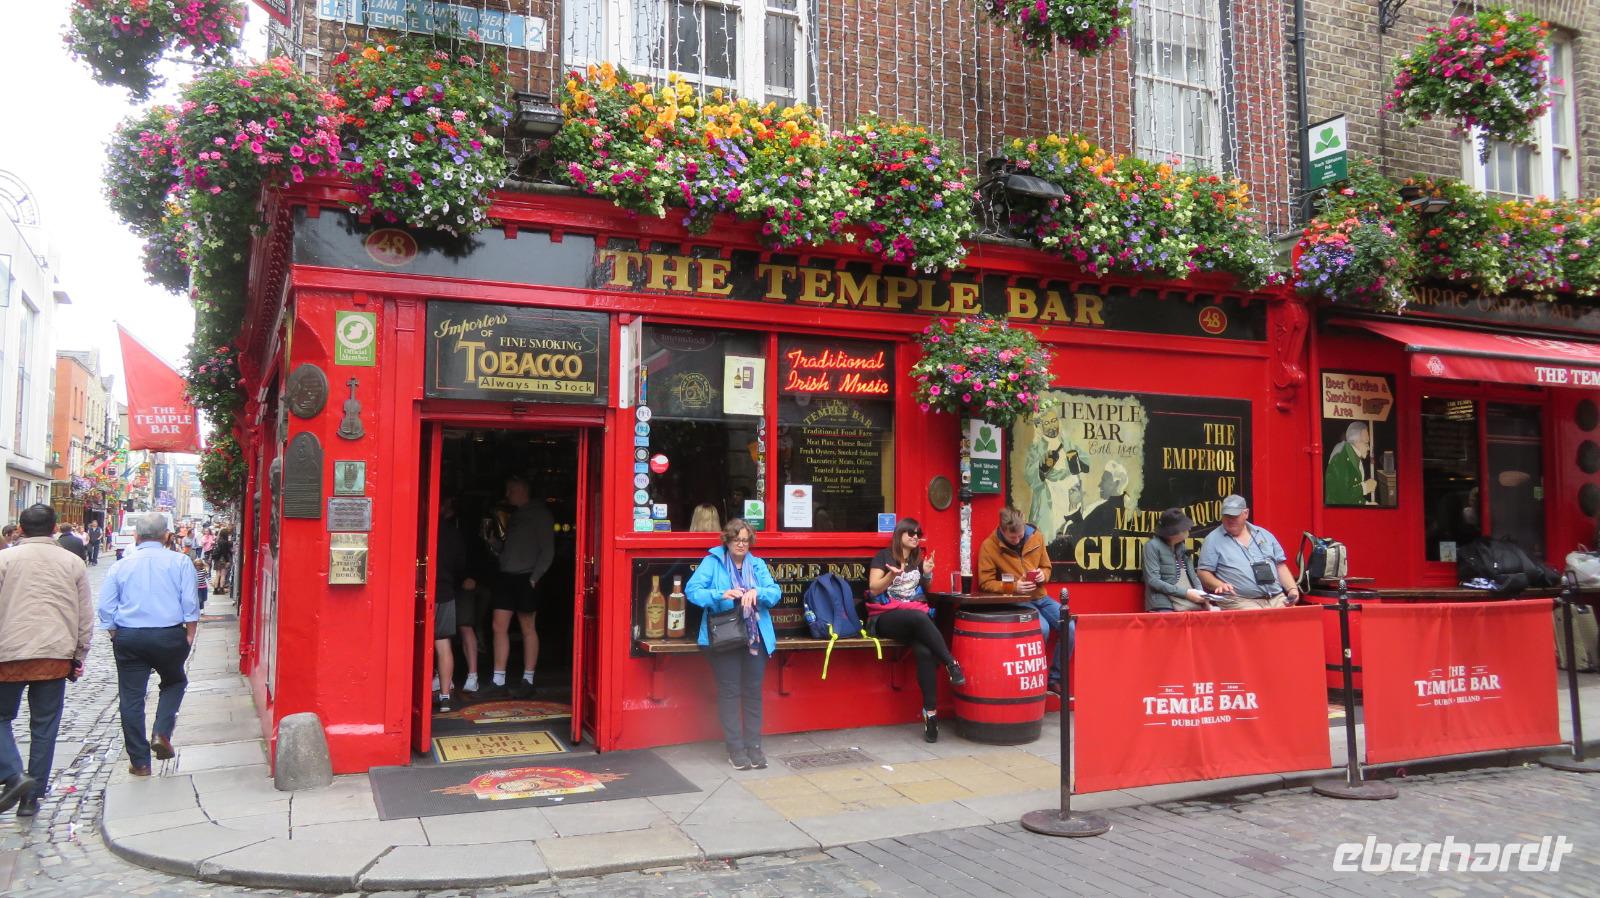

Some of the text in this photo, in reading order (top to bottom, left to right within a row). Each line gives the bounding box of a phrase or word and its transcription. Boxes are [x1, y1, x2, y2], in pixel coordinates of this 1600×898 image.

[529, 26, 543, 43] 2
[378, 233, 406, 257] 48
[599, 249, 1105, 325] THE TEMPLE BAR
[433, 314, 508, 340] Importers
[1202, 312, 1220, 328] 48
[480, 329, 495, 338] OF
[344, 348, 367, 356] Official
[499, 336, 583, 351] FINE SMOKING
[453, 340, 584, 384] TOBACCO
[787, 349, 885, 370] Traditional
[785, 370, 890, 394] Irish Music
[1325, 375, 1345, 390] Beer
[1347, 378, 1379, 393] Garden
[1534, 366, 1568, 384] THE
[479, 376, 593, 393] Always in Stock
[1325, 390, 1362, 406] Smoking
[133, 414, 193, 425] TEMPLE
[151, 406, 177, 415] THE
[802, 405, 873, 428] TEMPLE BAR
[1058, 401, 1143, 423] TEMPLE
[1333, 405, 1354, 418] Area
[151, 424, 182, 434] BAR
[802, 427, 839, 436] Traditional
[841, 428, 857, 437] Food
[1082, 422, 1124, 443] BAR
[1203, 423, 1236, 446] THE
[1162, 447, 1236, 471] EMPEROR
[1216, 476, 1236, 498] OF
[771, 563, 866, 581] MPLE BAR
[782, 596, 798, 605] 1840
[1015, 640, 1043, 658] THE
[1003, 655, 1048, 677] TEMPL
[1019, 674, 1045, 691] BAR
[1470, 674, 1502, 691] BAR
[1219, 692, 1260, 711] BAR
[1201, 715, 1232, 725] IRELAND
